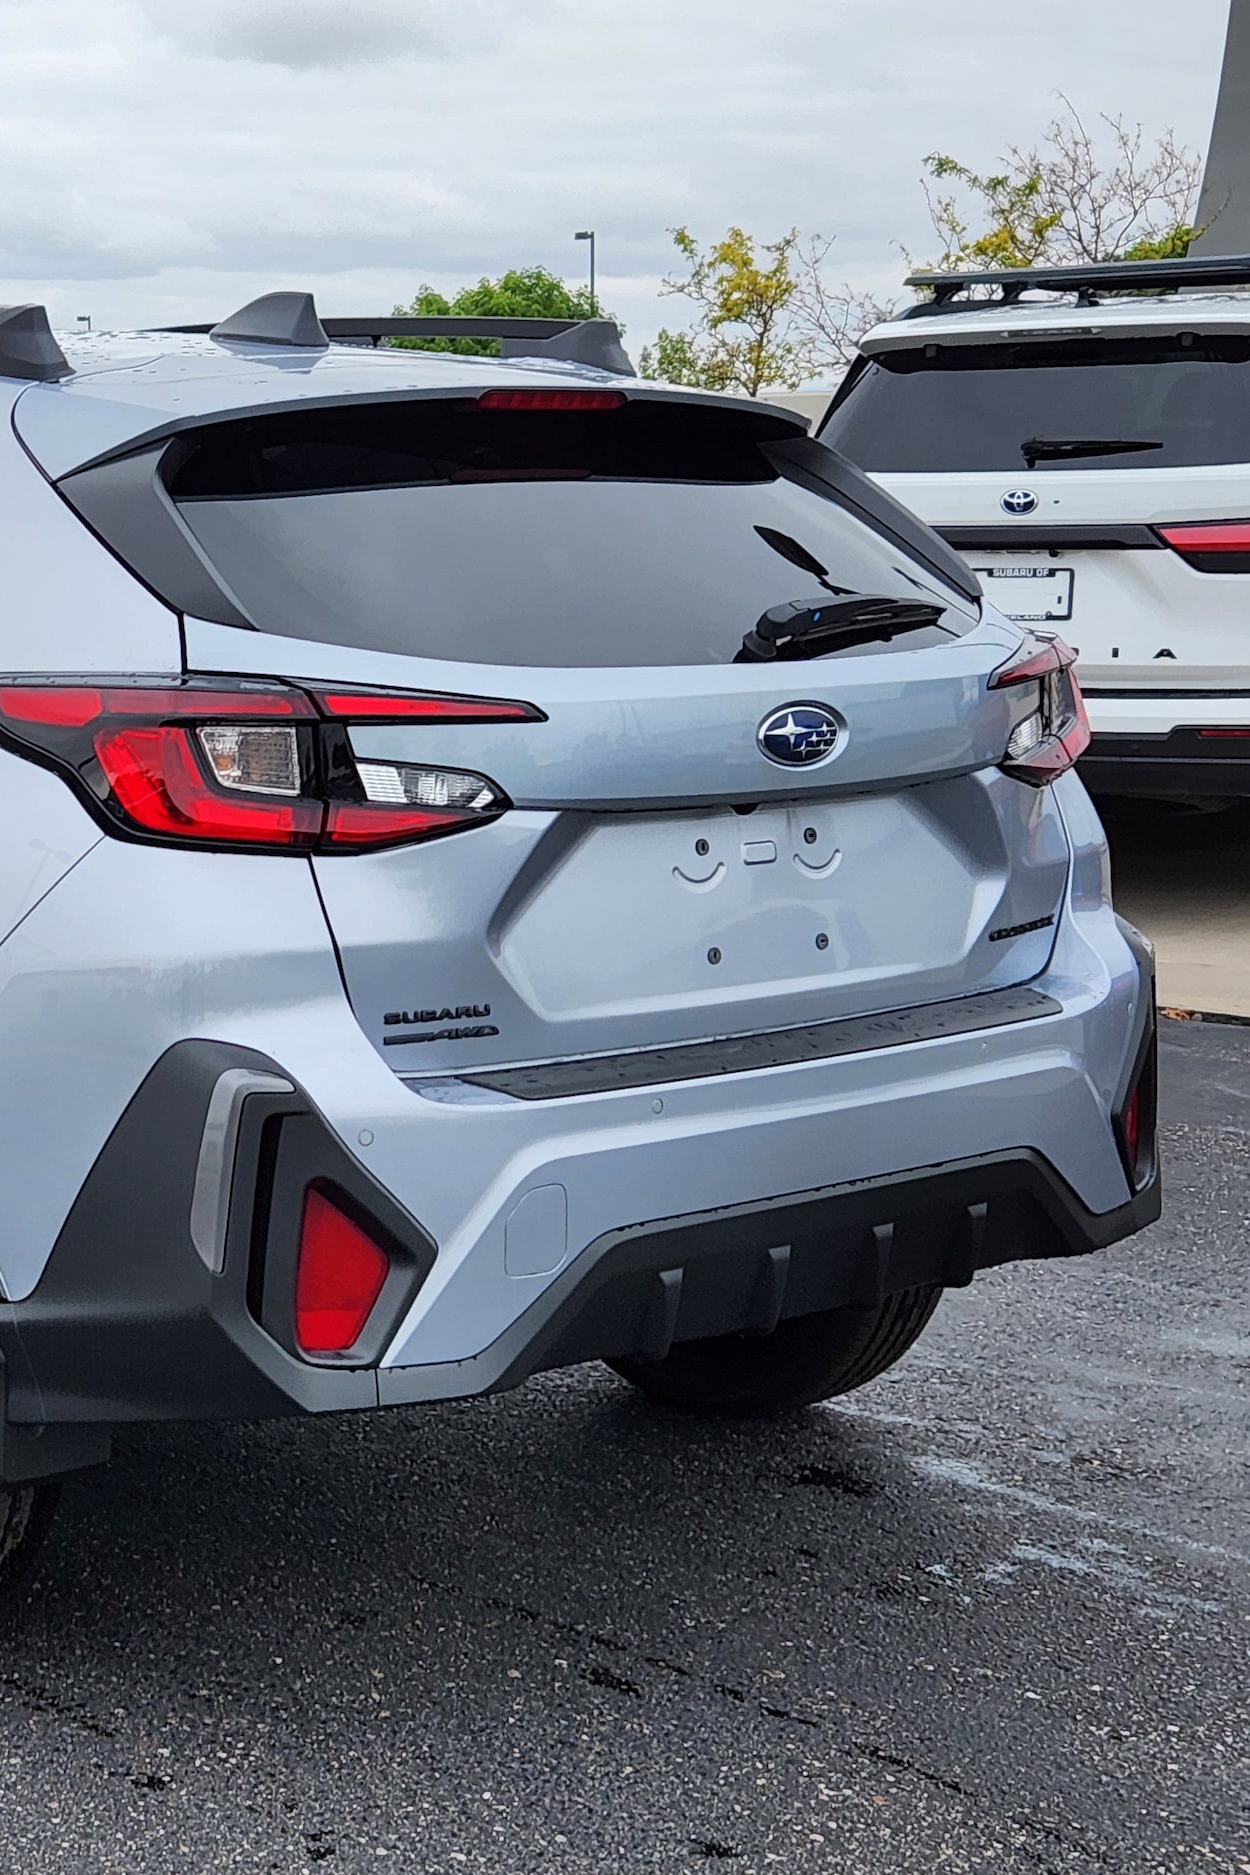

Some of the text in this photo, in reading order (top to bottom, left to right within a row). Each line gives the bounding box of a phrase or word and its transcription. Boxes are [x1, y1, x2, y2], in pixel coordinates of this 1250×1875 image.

[993, 567, 1049, 577] SUBARU OF
[383, 1004, 491, 1025] SUBARU
[427, 1025, 500, 1041] AWD
